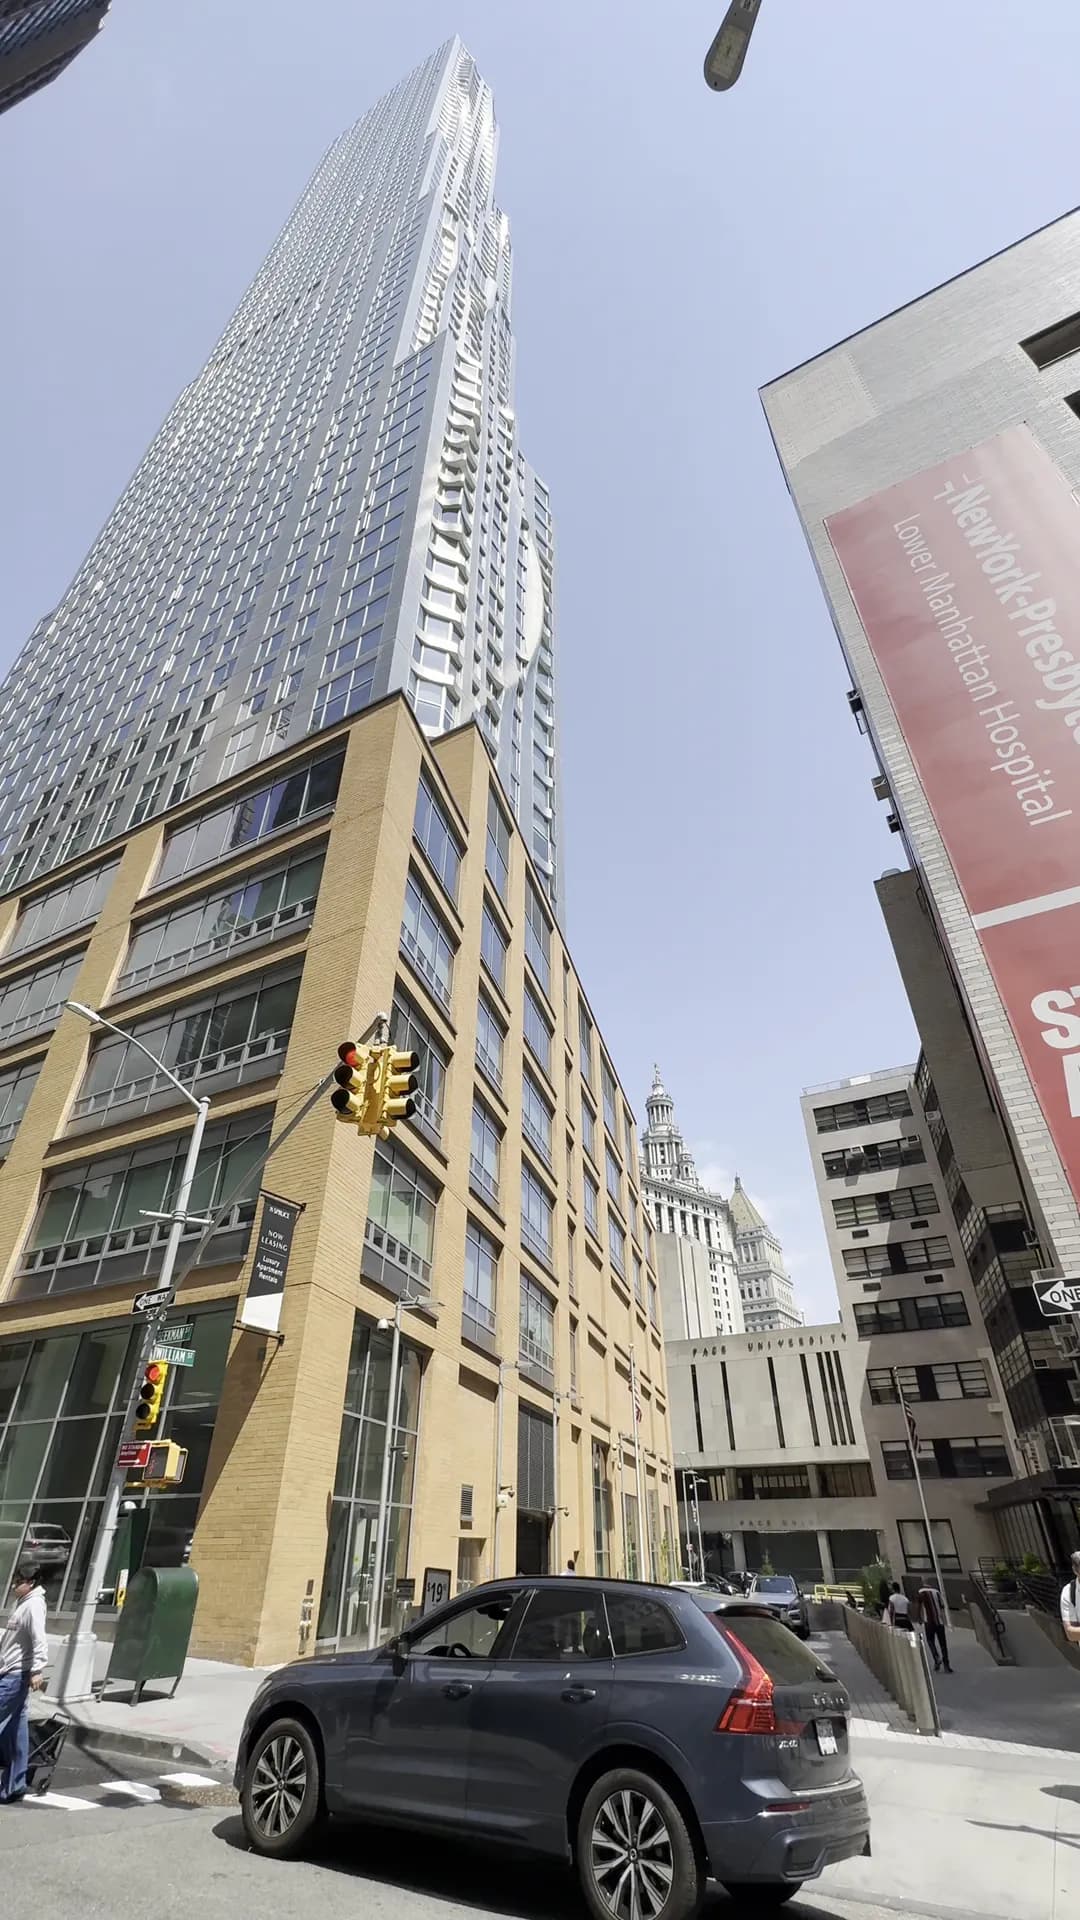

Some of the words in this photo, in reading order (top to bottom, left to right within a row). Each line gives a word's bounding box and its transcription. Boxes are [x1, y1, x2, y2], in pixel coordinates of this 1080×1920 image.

[893, 512, 937, 574] Lower
[920, 571, 998, 702] Manhattan
[979, 700, 1073, 826] Hospital
[1031, 985, 1080, 1049] S
[268, 1229, 284, 1241] NOW
[261, 1236, 288, 1252] LEASING
[1050, 1288, 1080, 1303] ONE
[155, 1347, 186, 1363] WILLIAM
[692, 1345, 727, 1358] PACE
